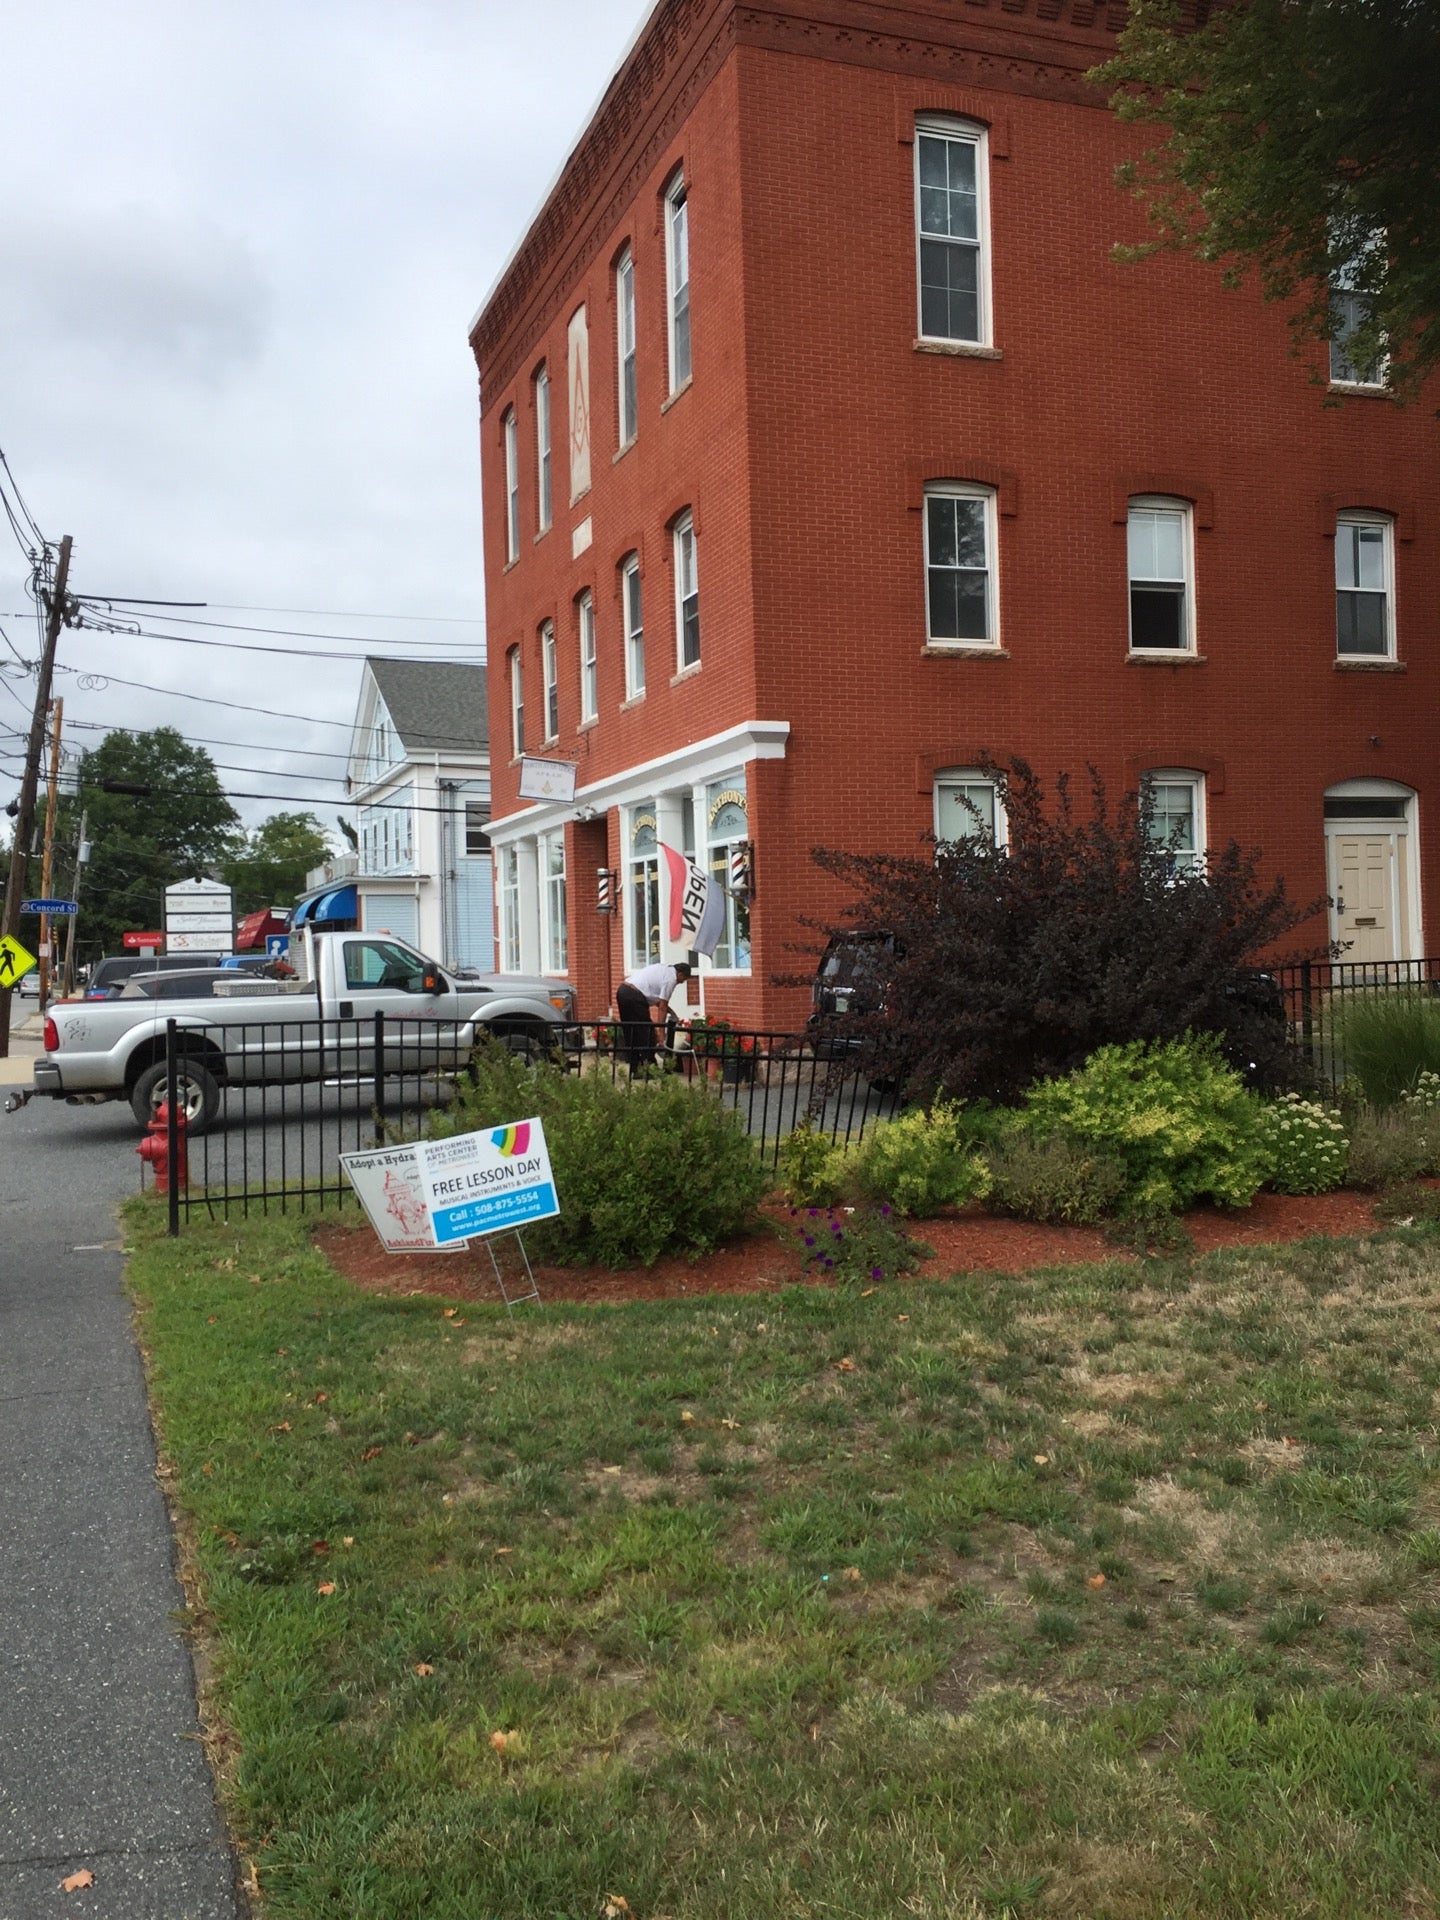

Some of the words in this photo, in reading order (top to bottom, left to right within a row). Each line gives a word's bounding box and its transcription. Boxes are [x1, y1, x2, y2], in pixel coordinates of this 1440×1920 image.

[30, 903, 65, 912] Concord
[67, 904, 76, 913] St
[425, 1138, 476, 1154] PERFORMING
[427, 1152, 446, 1161] ARTS
[448, 1145, 478, 1156] CENTER
[350, 1159, 376, 1169] Adopt
[384, 1152, 416, 1166] Hydra
[438, 1151, 479, 1165] METROWEST
[432, 1177, 464, 1197] FREE
[466, 1164, 515, 1188] LESSON
[517, 1157, 542, 1175] DAY
[439, 1194, 469, 1206] MUSICAL
[469, 1181, 516, 1198] INSTRUMENTS
[523, 1174, 542, 1184] VOICE
[449, 1208, 468, 1222] Call
[474, 1190, 539, 1216] 508-875-5554
[451, 1203, 542, 1232] www.pacmetrowest.org
